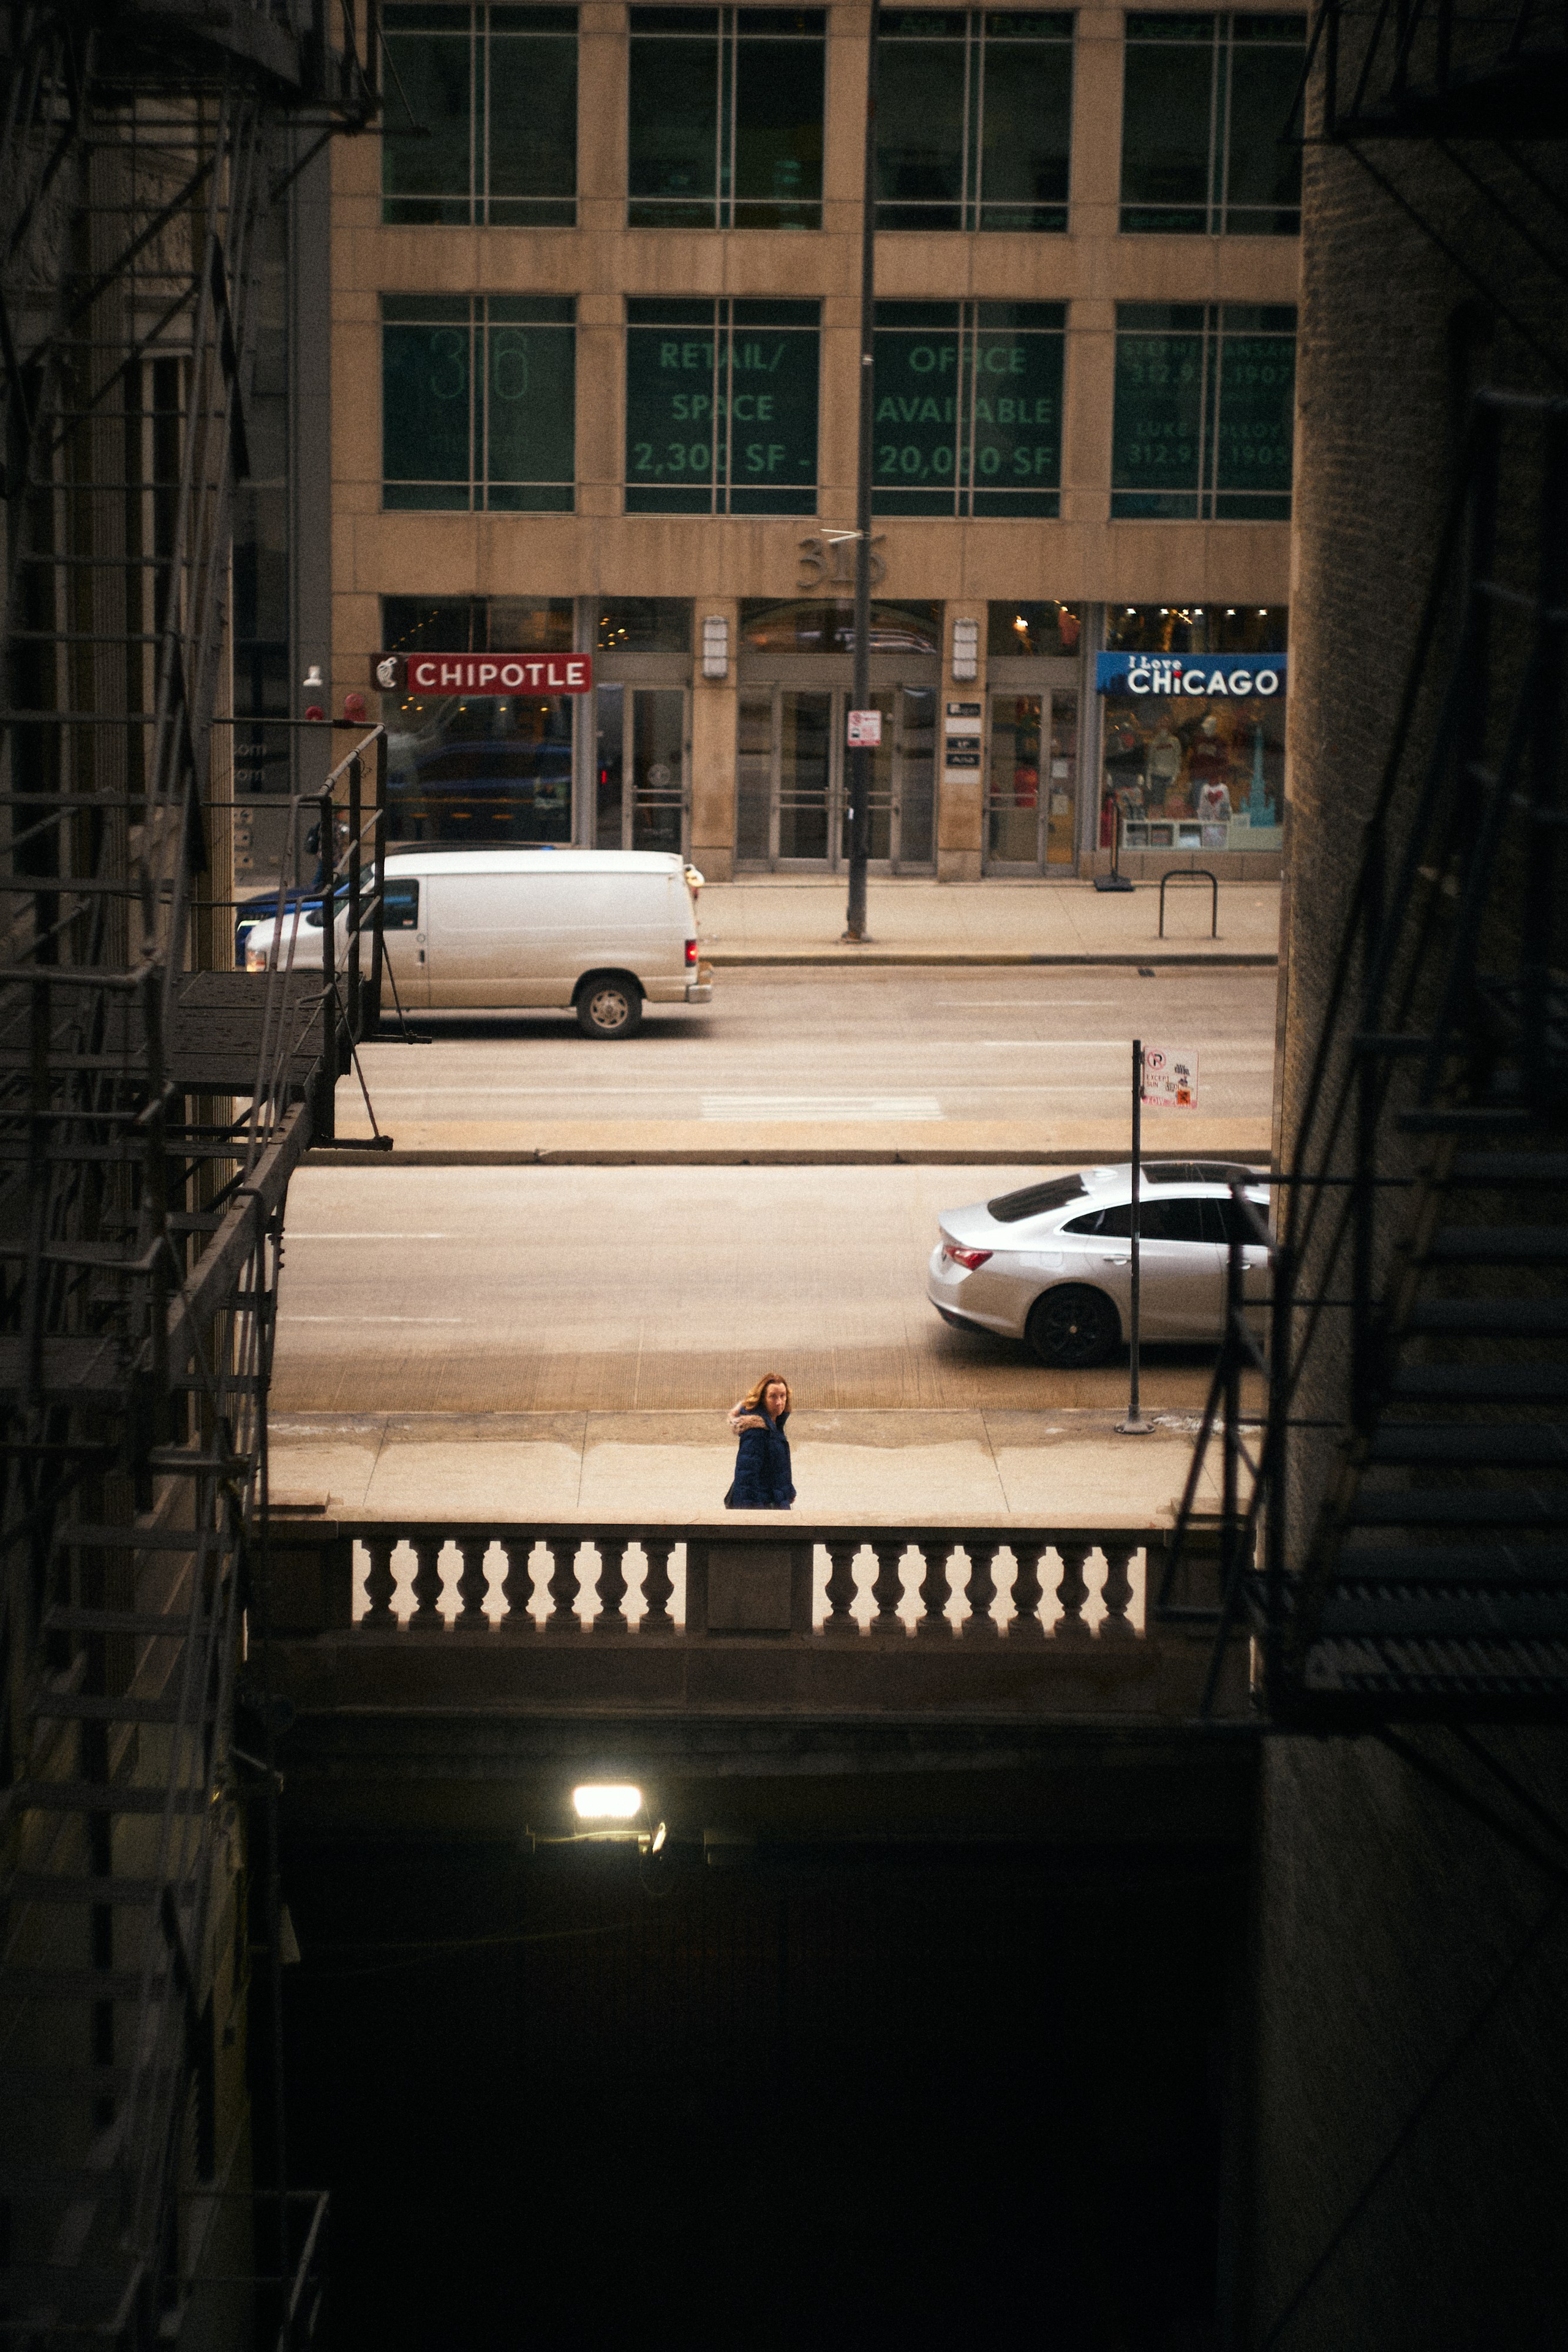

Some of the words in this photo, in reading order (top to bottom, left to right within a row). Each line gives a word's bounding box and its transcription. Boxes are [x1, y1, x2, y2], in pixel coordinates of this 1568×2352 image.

[660, 342, 786, 372] RETAIL/
[671, 394, 774, 421] SPACE
[745, 443, 786, 473] SF
[1013, 447, 1054, 475] SF
[415, 662, 586, 687] CHIPOTLE
[1128, 655, 1136, 668] I
[1140, 655, 1183, 670] Love
